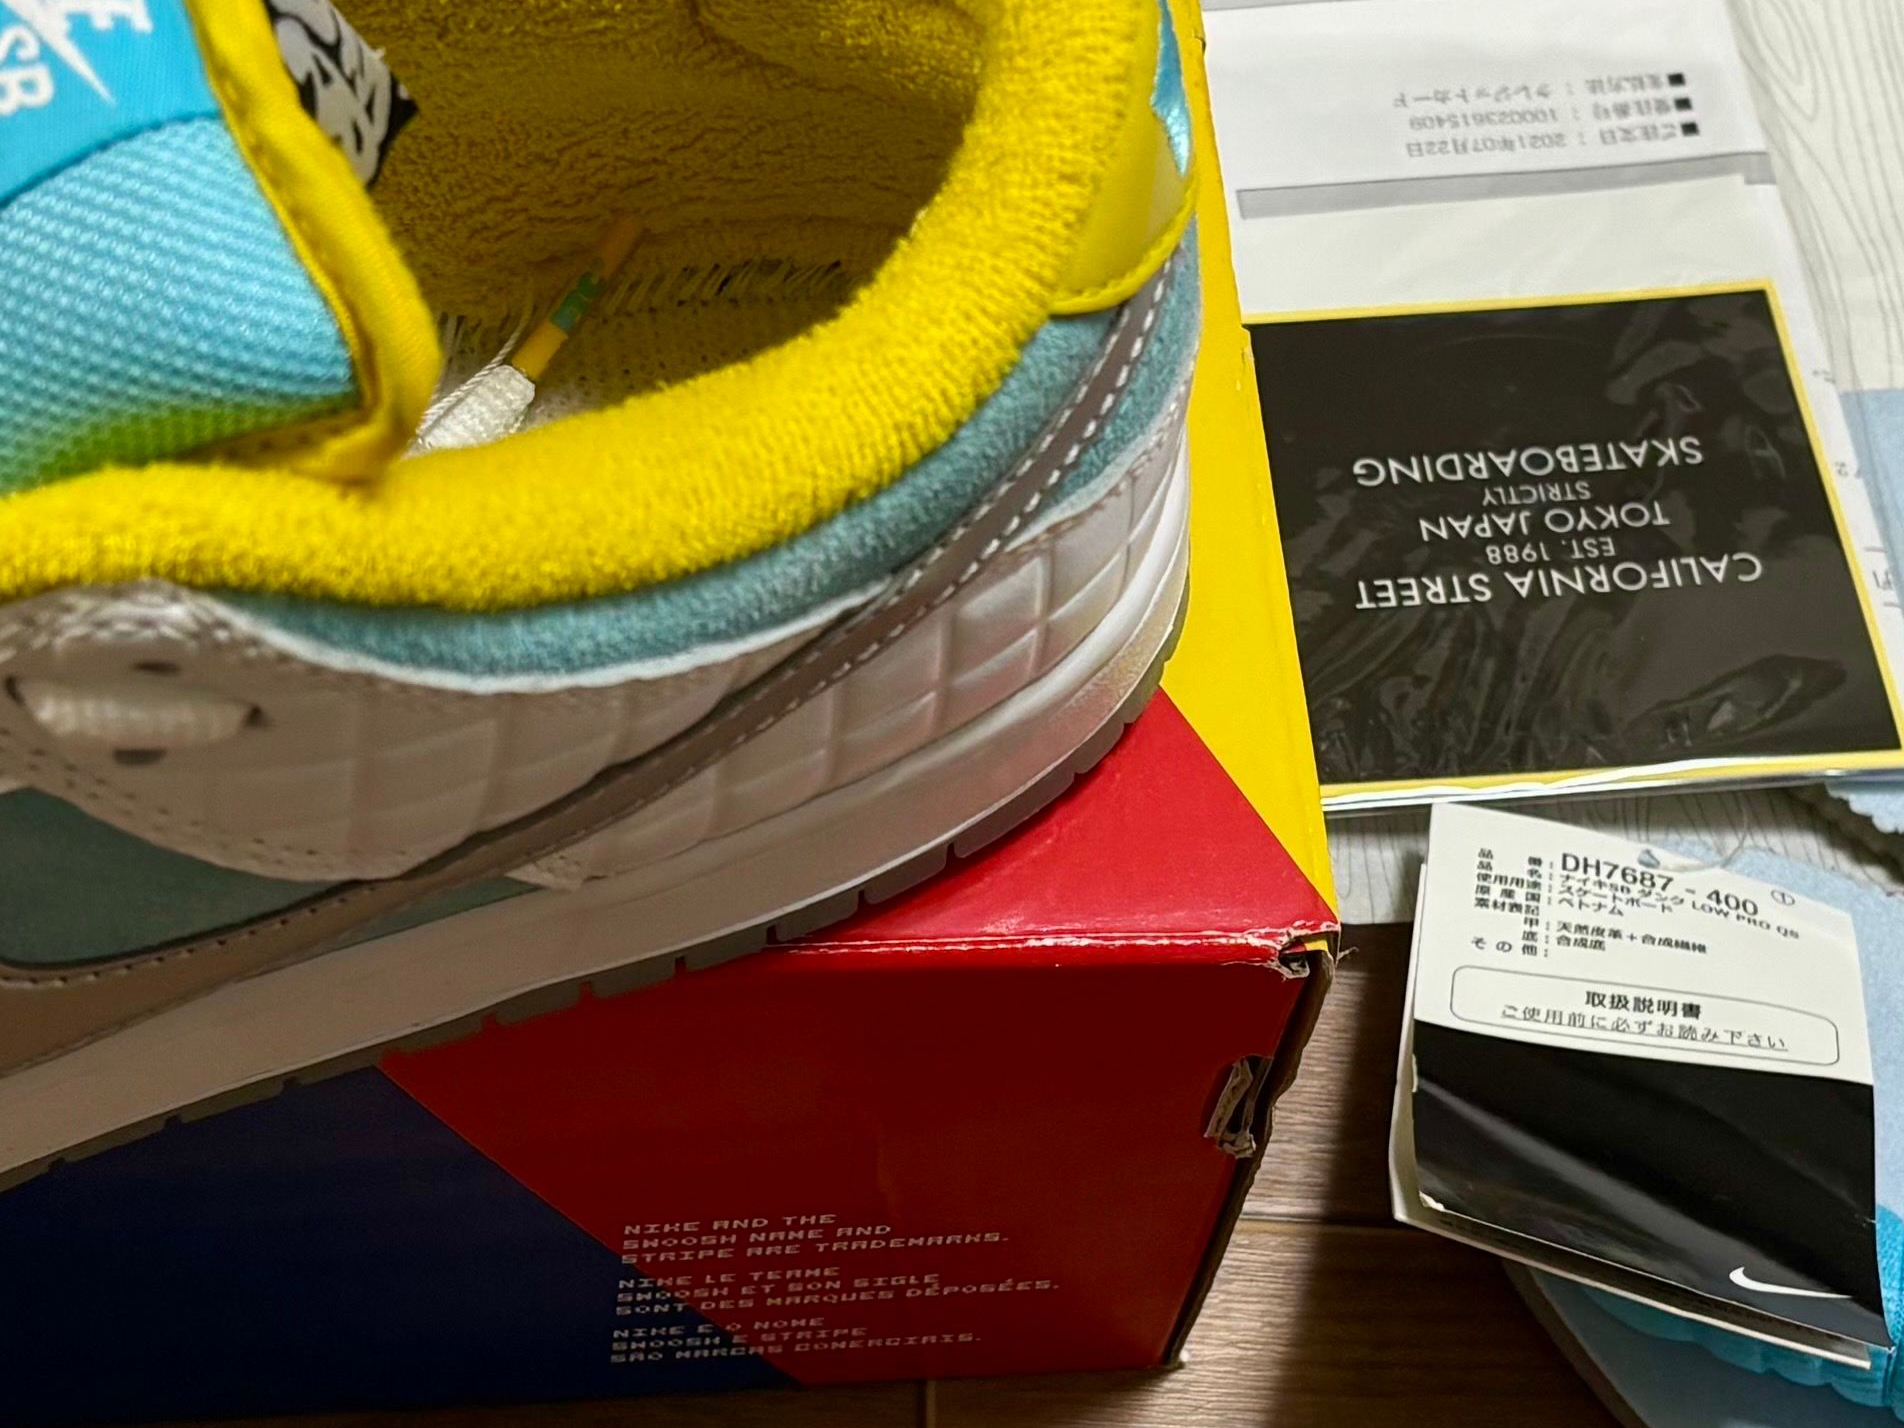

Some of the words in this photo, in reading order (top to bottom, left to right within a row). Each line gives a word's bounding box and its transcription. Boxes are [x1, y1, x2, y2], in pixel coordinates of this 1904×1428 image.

[1353, 435, 1704, 487] SKATEBOARDING
[1482, 480, 1592, 506] STRICTLY
[1419, 510, 1531, 542] JAPAN
[1545, 500, 1671, 534] TOKYO
[1486, 541, 1545, 565] 1988
[1560, 536, 1616, 559] EST.
[1504, 552, 1763, 599] CALIFORNIA
[1355, 572, 1493, 610] STREET
[1561, 852, 1674, 892] DH7687
[1706, 889, 1758, 917] 400
[1558, 897, 1624, 917] ベトナム
[1691, 900, 1729, 918] LOW
[1585, 990, 1702, 1020] 取扱説明書
[624, 1222, 700, 1235] NIKE
[712, 1218, 769, 1231] AND
[782, 1214, 838, 1225] THE
[623, 1234, 737, 1250] SWOOSH
[749, 1229, 824, 1243] NAME
[836, 1225, 891, 1237] AND
[621, 1248, 735, 1265] STRIPE
[617, 1285, 729, 1302] SWOOSH
[619, 1275, 693, 1289] NIKE
[615, 1303, 688, 1316] SONT
[700, 1299, 755, 1311] DES
[612, 1336, 721, 1351] SWOOSH
[613, 1326, 685, 1338] NIKE
